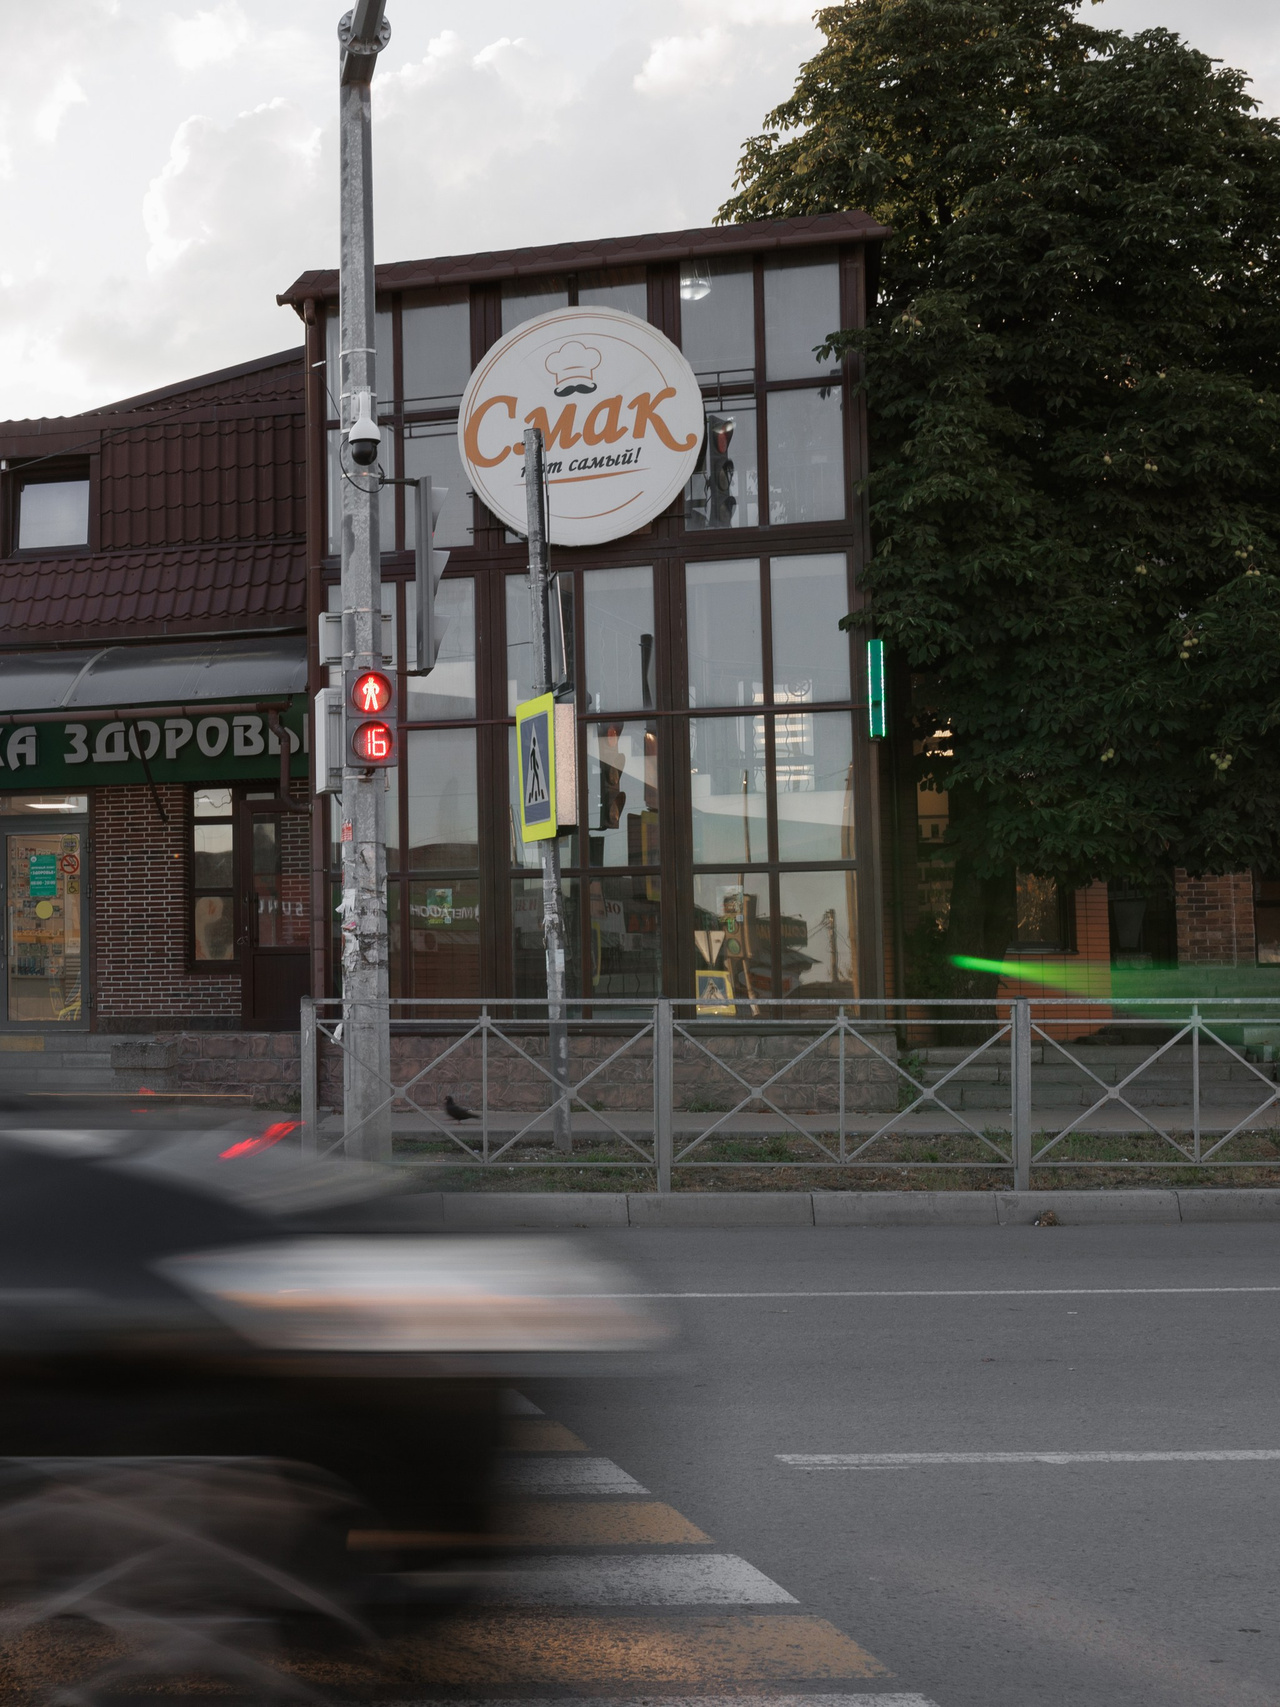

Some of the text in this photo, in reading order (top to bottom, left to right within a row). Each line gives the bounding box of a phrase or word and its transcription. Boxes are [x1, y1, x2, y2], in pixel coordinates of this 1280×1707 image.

[463, 387, 698, 468] Смак
[568, 447, 642, 474] самый!
[63, 713, 309, 764] ЗДОРОВЬ
[367, 728, 386, 756] 16
